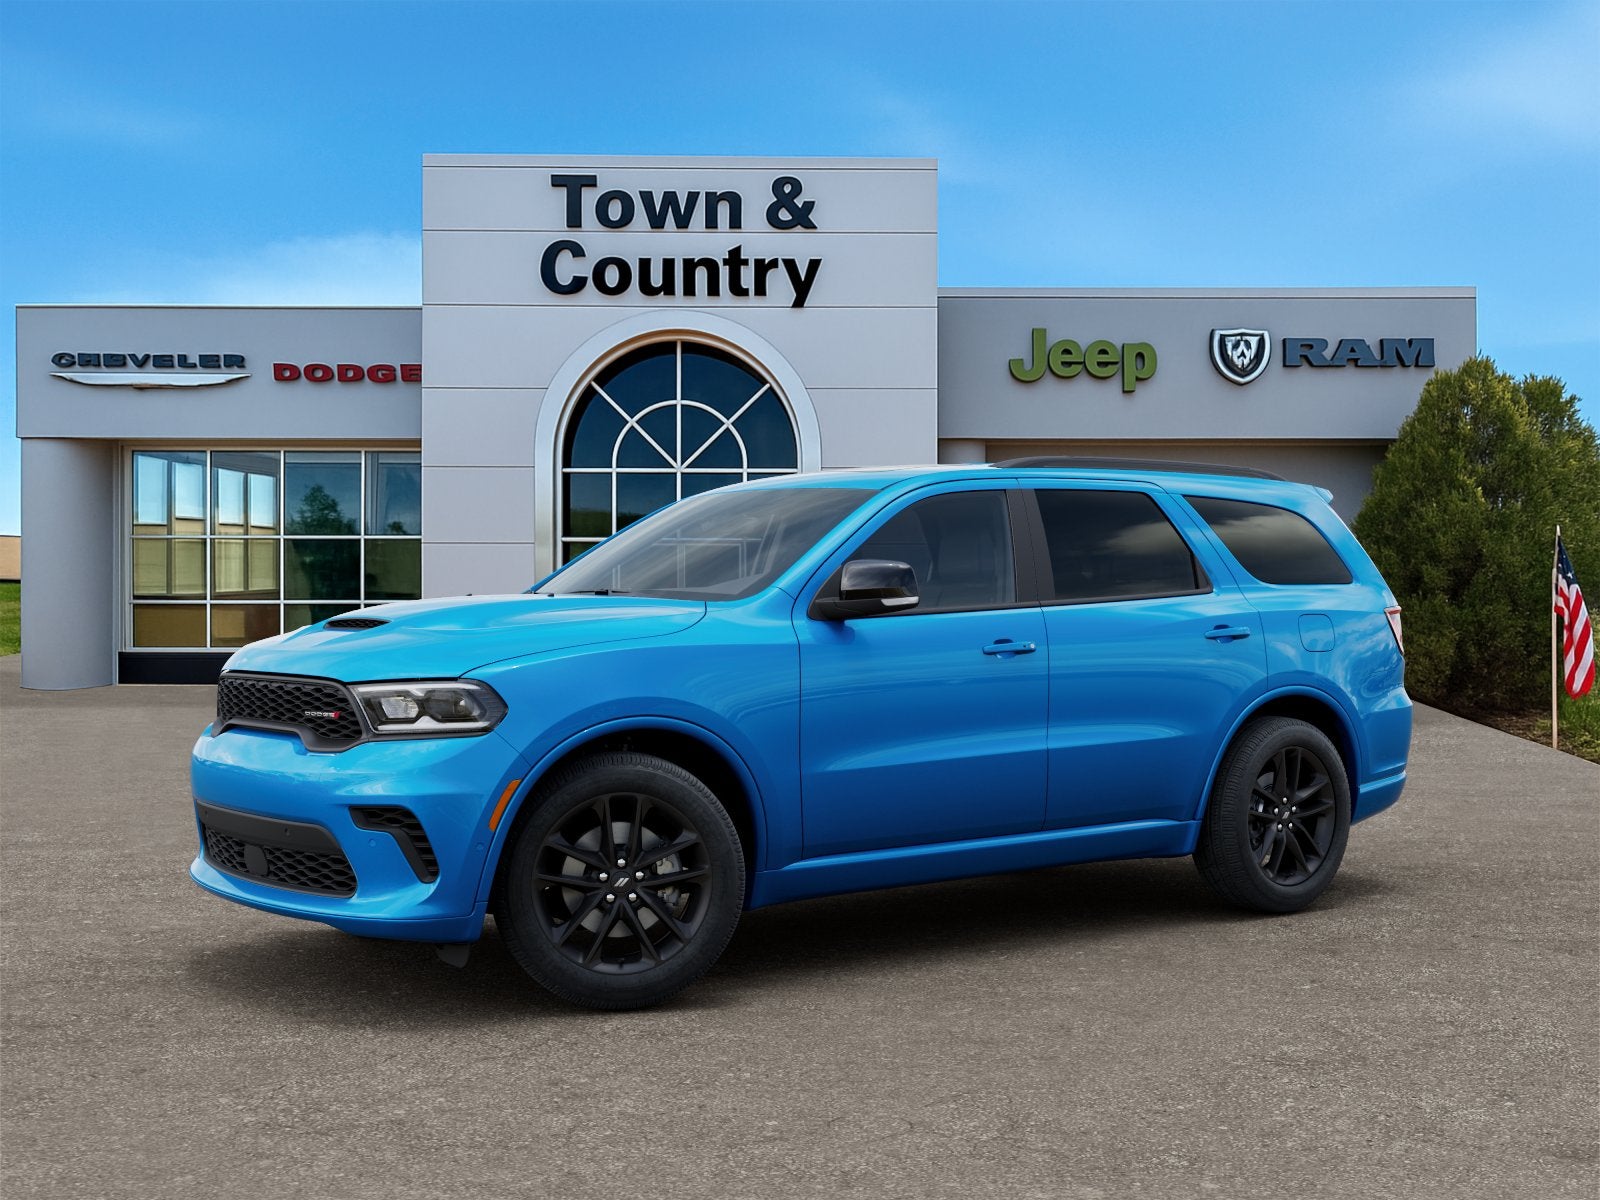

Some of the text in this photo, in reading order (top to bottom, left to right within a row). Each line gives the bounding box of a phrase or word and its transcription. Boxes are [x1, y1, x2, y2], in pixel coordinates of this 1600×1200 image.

[550, 174, 818, 230] Town &
[540, 239, 822, 308] Country
[273, 362, 422, 383] DODGE
[1009, 328, 1157, 393] Jeep
[1282, 337, 1436, 368] RAM
